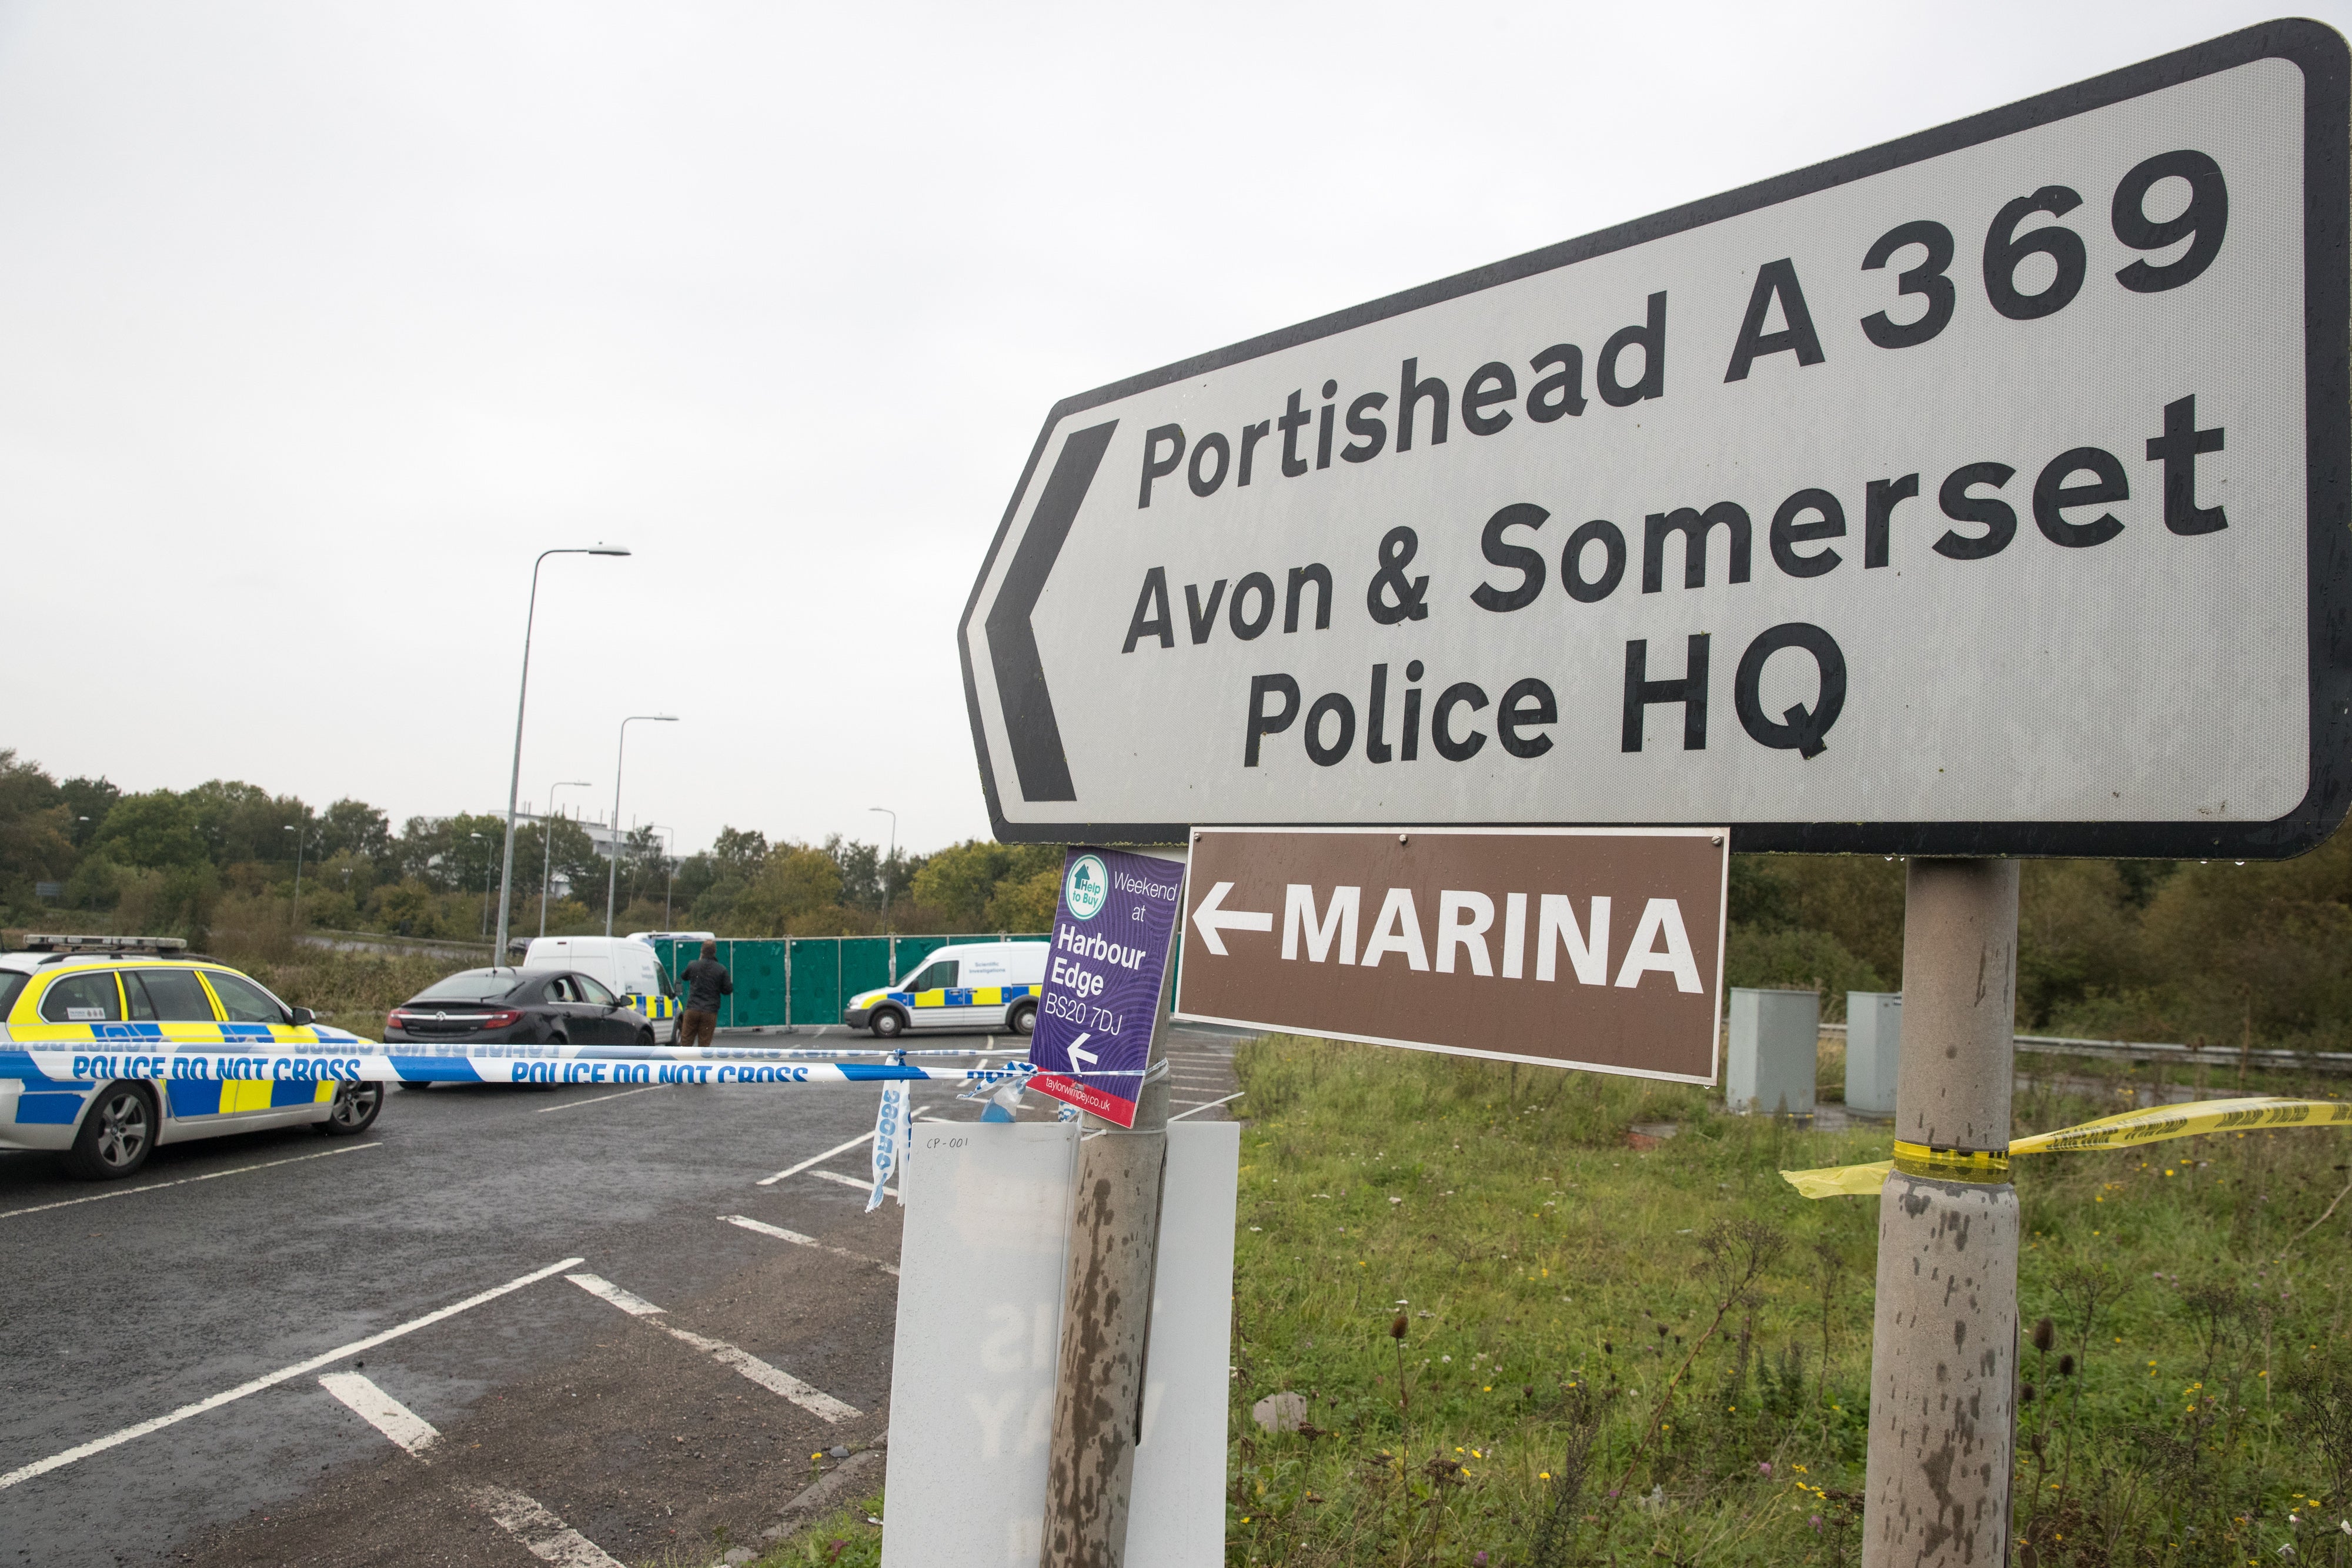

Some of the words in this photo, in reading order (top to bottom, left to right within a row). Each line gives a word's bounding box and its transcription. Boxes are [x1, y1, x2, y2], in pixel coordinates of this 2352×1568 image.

[1138, 290, 1667, 510] Portishead
[1121, 563, 1333, 654] Avon
[1367, 526, 1429, 625] &
[1469, 393, 2229, 613] Somerset
[1244, 660, 1558, 767] Police
[1621, 622, 1847, 760] HQ
[1073, 891, 1081, 901] to
[1083, 895, 1098, 908] Buy
[1081, 880, 1101, 895] Help
[1114, 871, 1178, 902] Weekend
[1132, 905, 1146, 922] at
[1057, 923, 1146, 970] Harbour
[1281, 883, 1704, 994] MARINA
[1051, 957, 1104, 998] Edge
[1045, 992, 1087, 1024] BS20
[1091, 1007, 1122, 1035] 7DJ
[73, 1055, 166, 1080] POLICE
[172, 1057, 206, 1080] DO
[217, 1057, 269, 1081] NOT
[273, 1058, 361, 1081] CROSS
[512, 1062, 607, 1084] POLICE
[614, 1064, 649, 1084] DO
[659, 1064, 713, 1084] NOT
[717, 1065, 808, 1084] CROSS
[1046, 1076, 1111, 1112] taylorwimpey.co.uk
